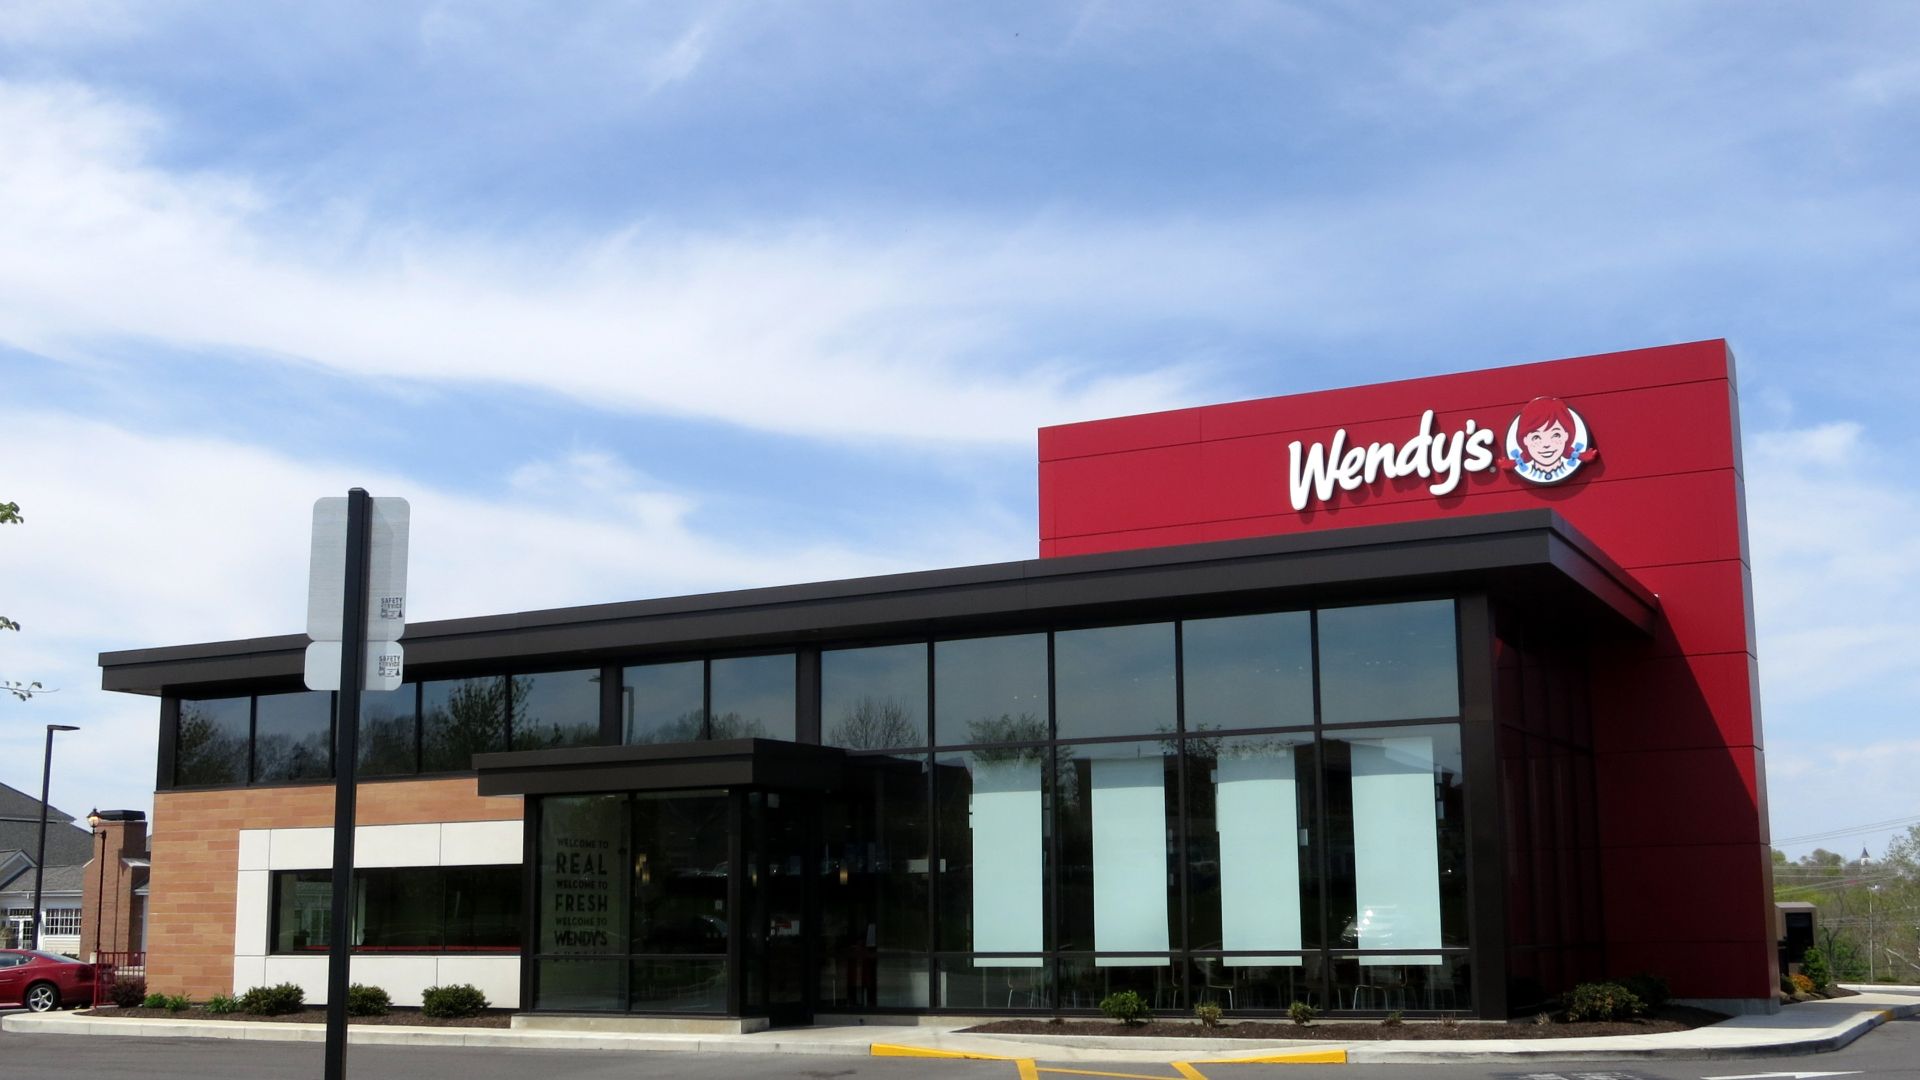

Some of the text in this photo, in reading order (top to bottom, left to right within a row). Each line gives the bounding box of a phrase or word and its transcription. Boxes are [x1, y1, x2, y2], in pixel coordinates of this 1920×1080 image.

[1288, 409, 1494, 511] Wendy's
[557, 838, 609, 849] WELCOME TO
[556, 852, 607, 875] REAL
[556, 879, 608, 890] WELCOME TO
[555, 894, 608, 912] FRESH
[555, 917, 608, 926] WELCOME TO
[554, 930, 608, 946] WENDY'S
